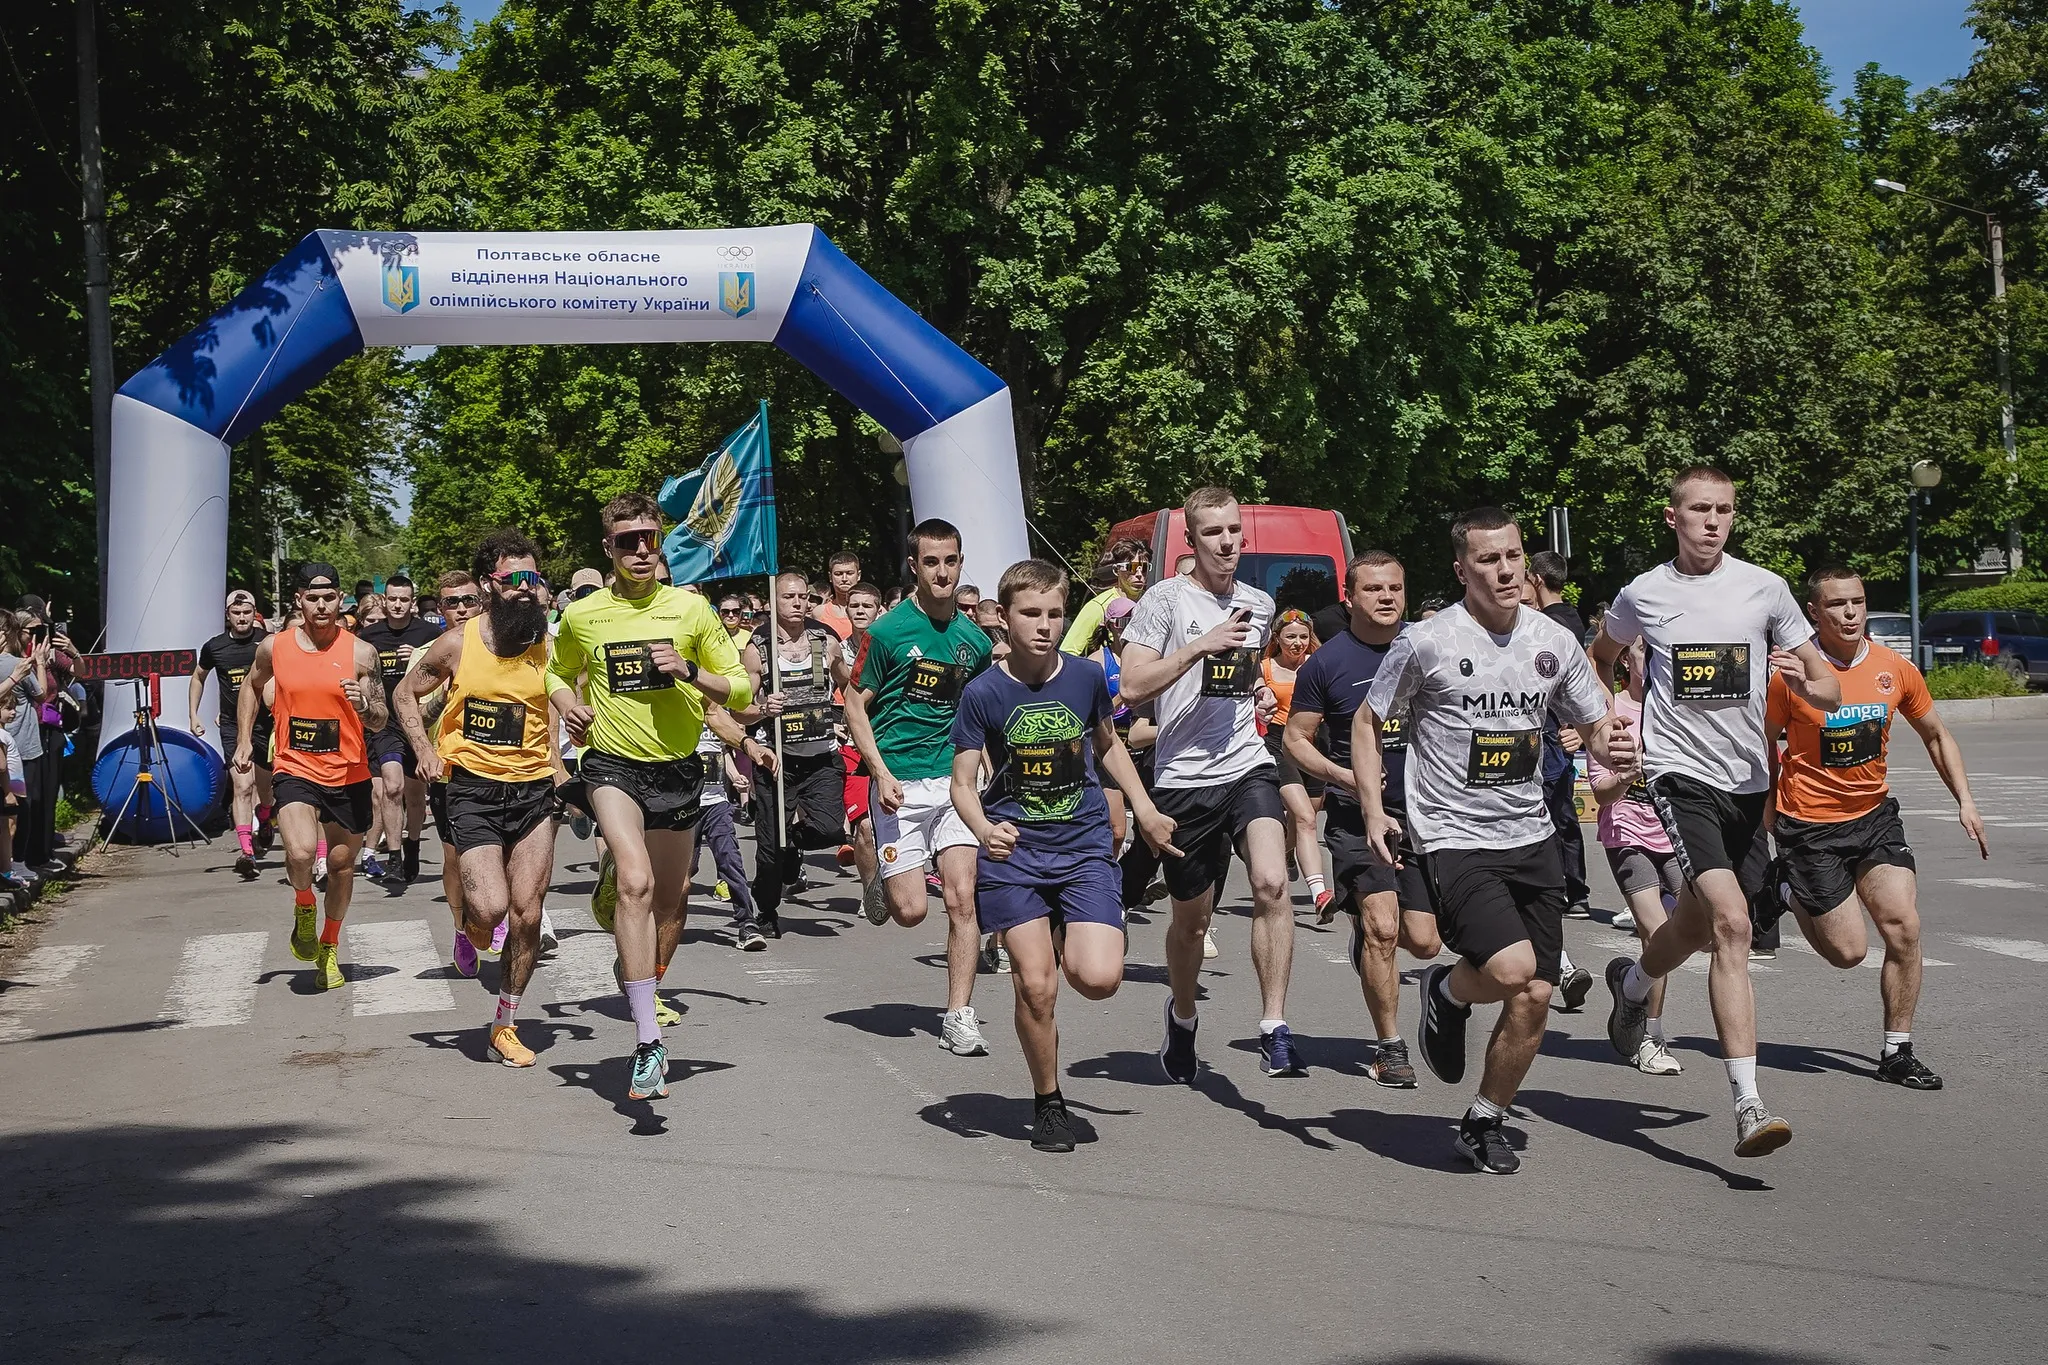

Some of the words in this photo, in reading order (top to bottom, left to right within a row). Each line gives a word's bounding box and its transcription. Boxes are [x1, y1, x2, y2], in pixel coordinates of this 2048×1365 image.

[477, 248, 582, 262] Полтавське
[587, 250, 661, 263] обласне
[451, 269, 549, 286] відділення
[555, 270, 688, 288] Національного
[429, 292, 557, 309] олімпійського
[562, 296, 638, 313] комітету
[643, 296, 710, 314] України
[1186, 628, 1204, 636] PEAK
[382, 659, 397, 667] 397
[615, 660, 643, 676] 353
[914, 672, 938, 687] 119
[1211, 665, 1236, 680] 117
[1682, 665, 1716, 681] 399
[1462, 691, 1547, 711] MIAMI
[470, 713, 496, 729] 200
[785, 721, 805, 732] 351
[295, 730, 317, 741] 547
[1830, 740, 1854, 754] 191
[1479, 751, 1511, 767] 149
[1022, 761, 1053, 776] 143
